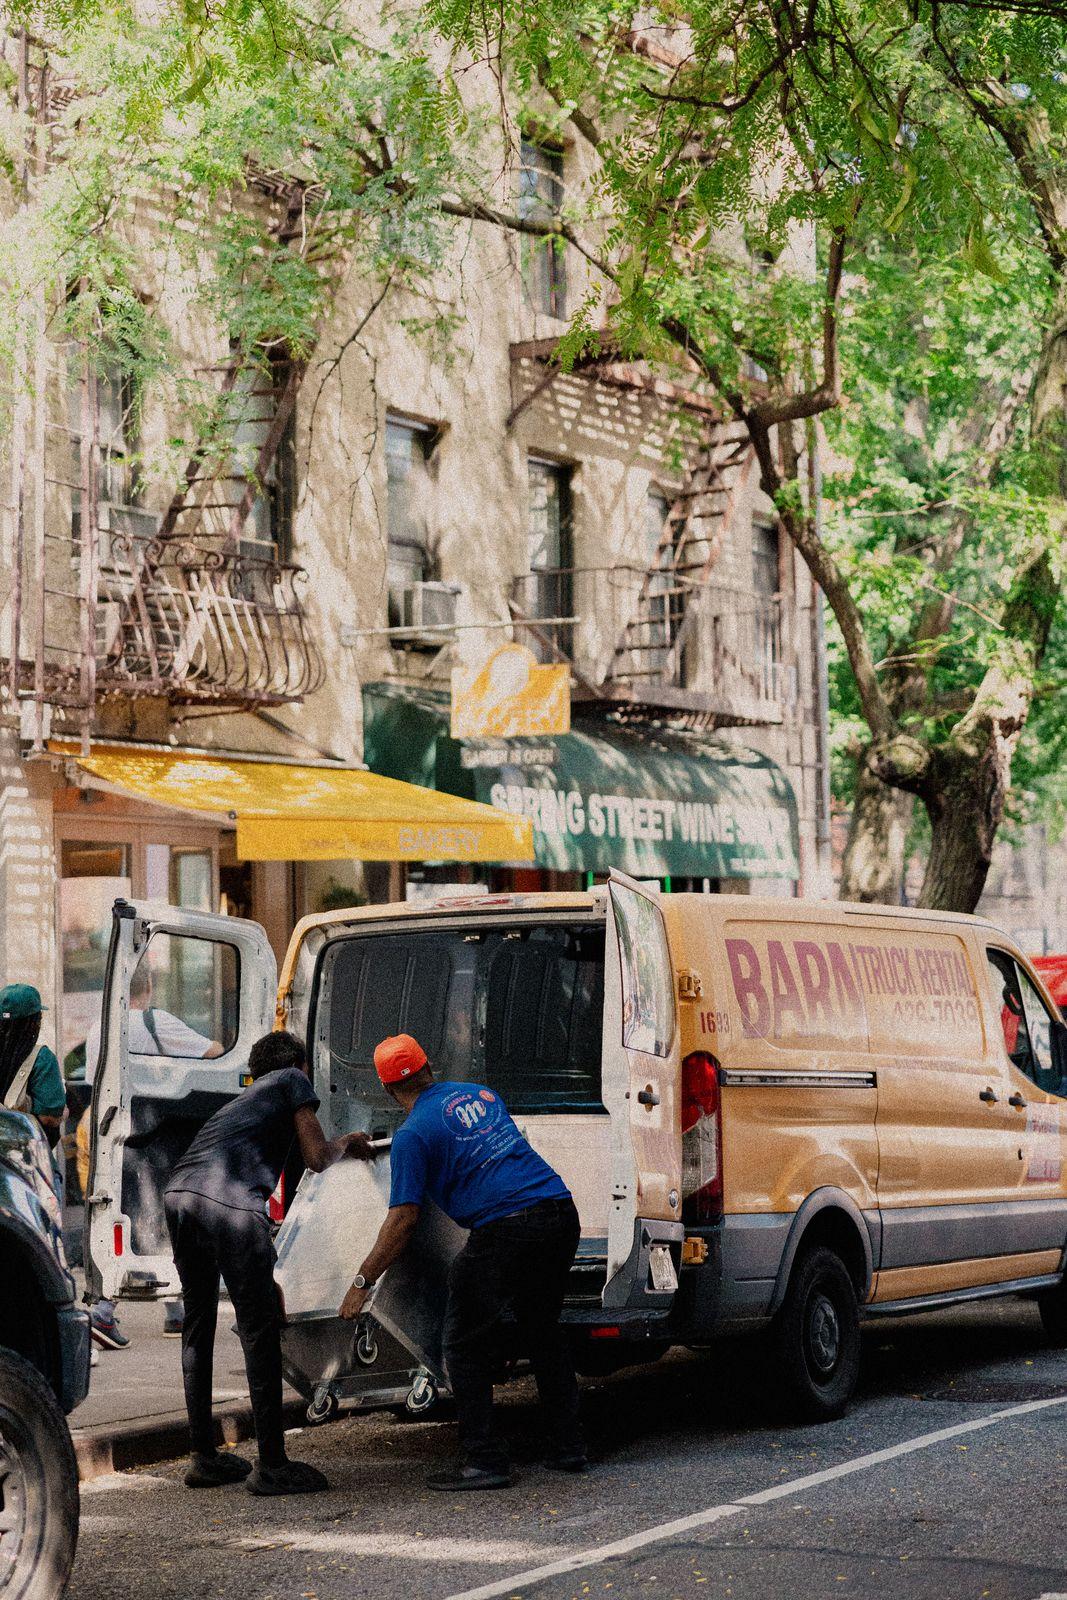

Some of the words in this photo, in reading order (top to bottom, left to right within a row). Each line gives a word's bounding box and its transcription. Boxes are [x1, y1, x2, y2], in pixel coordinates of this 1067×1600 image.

[524, 749, 555, 764] OPEN
[490, 782, 585, 836] SPRING
[588, 793, 677, 841] STREET
[677, 801, 734, 845] WINE
[398, 827, 482, 853] BAKERY
[725, 939, 863, 1040] BARN
[855, 944, 917, 996] TRUCK
[914, 949, 979, 998] RENTAL
